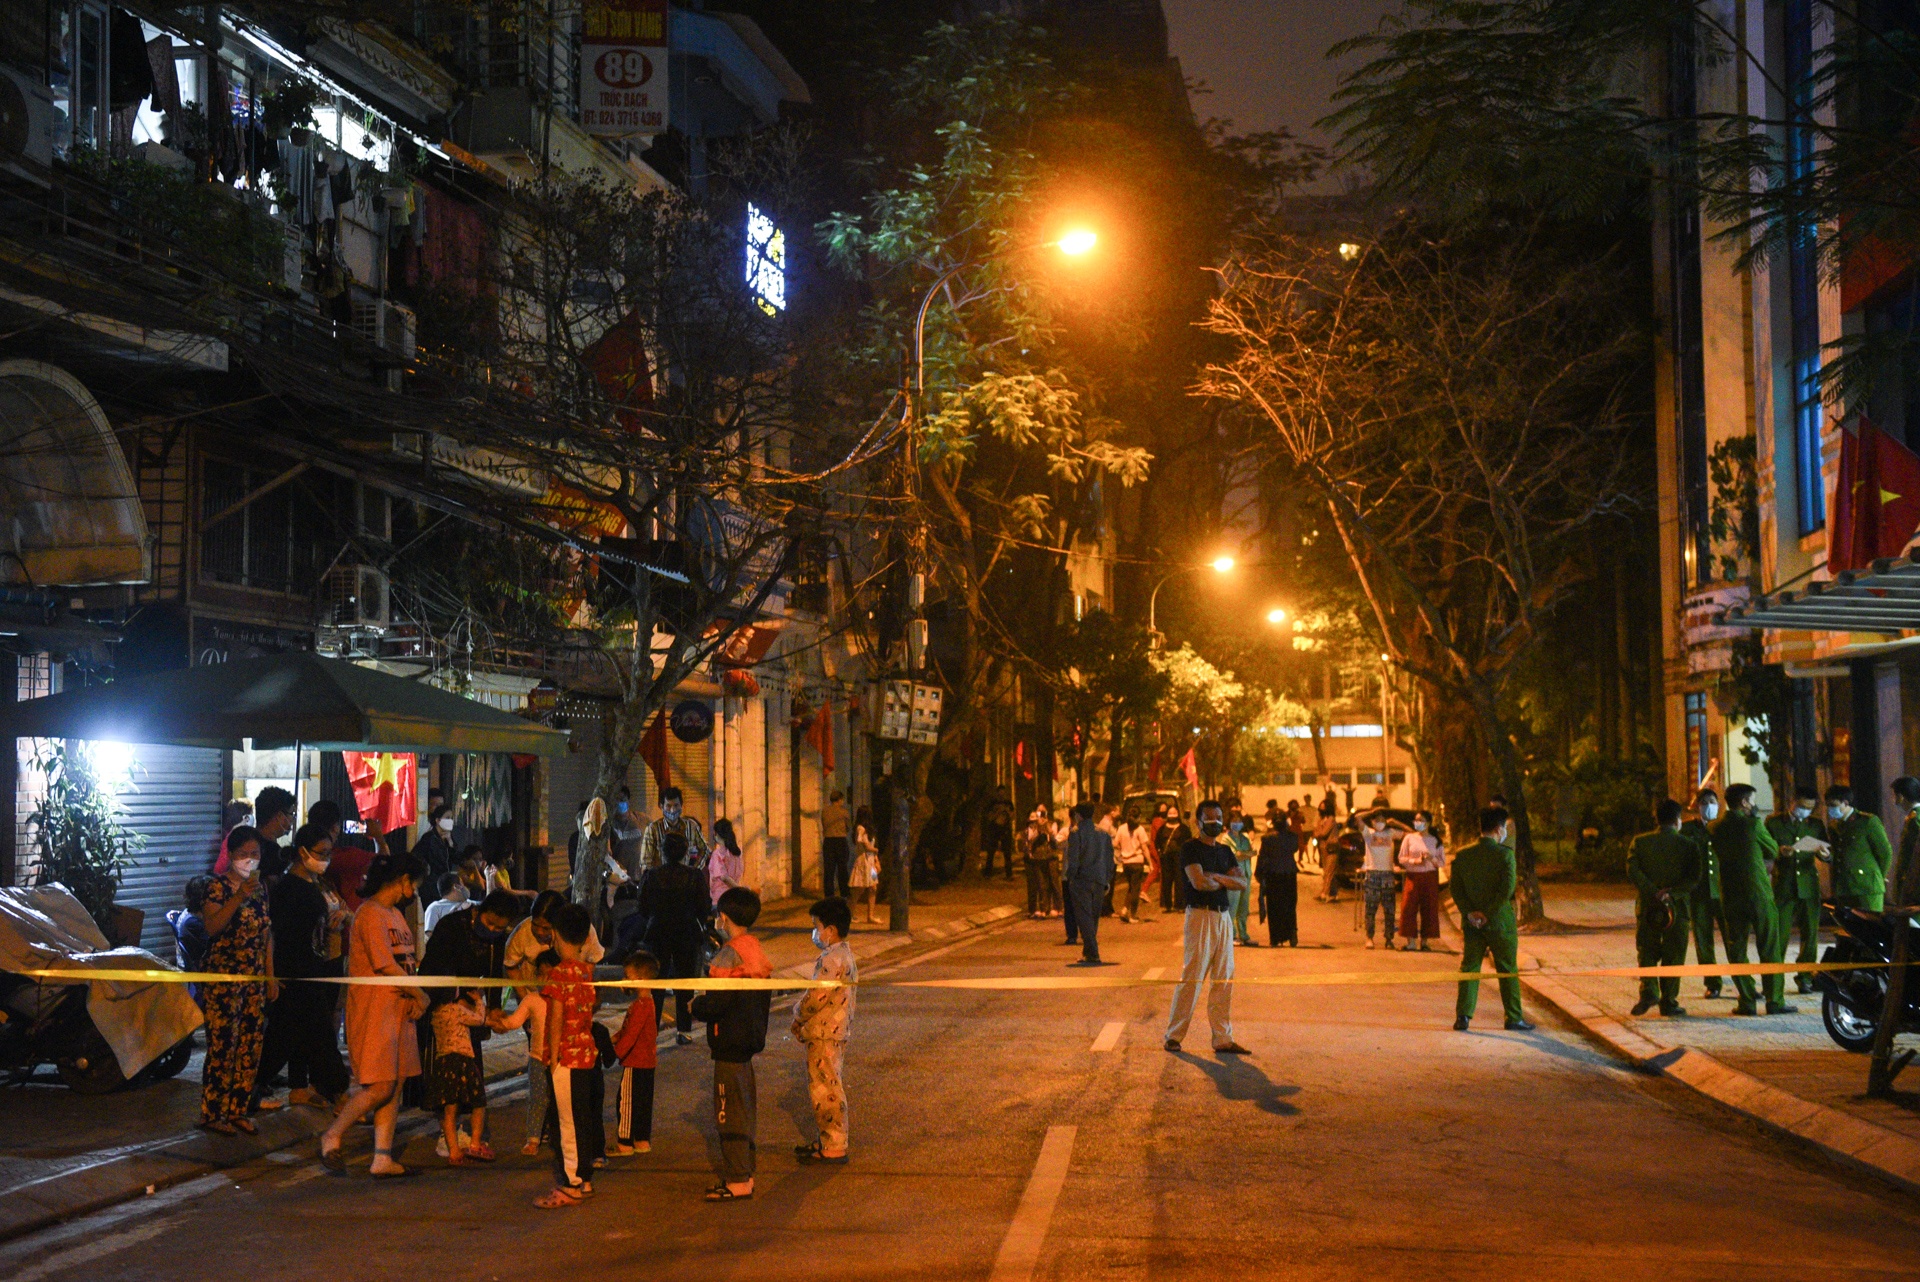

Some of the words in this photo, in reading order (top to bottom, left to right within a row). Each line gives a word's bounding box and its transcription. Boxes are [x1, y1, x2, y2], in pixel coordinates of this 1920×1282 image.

[605, 52, 643, 83] 89
[599, 90, 622, 107] TRÚC
[718, 1083, 726, 1124] NYC
